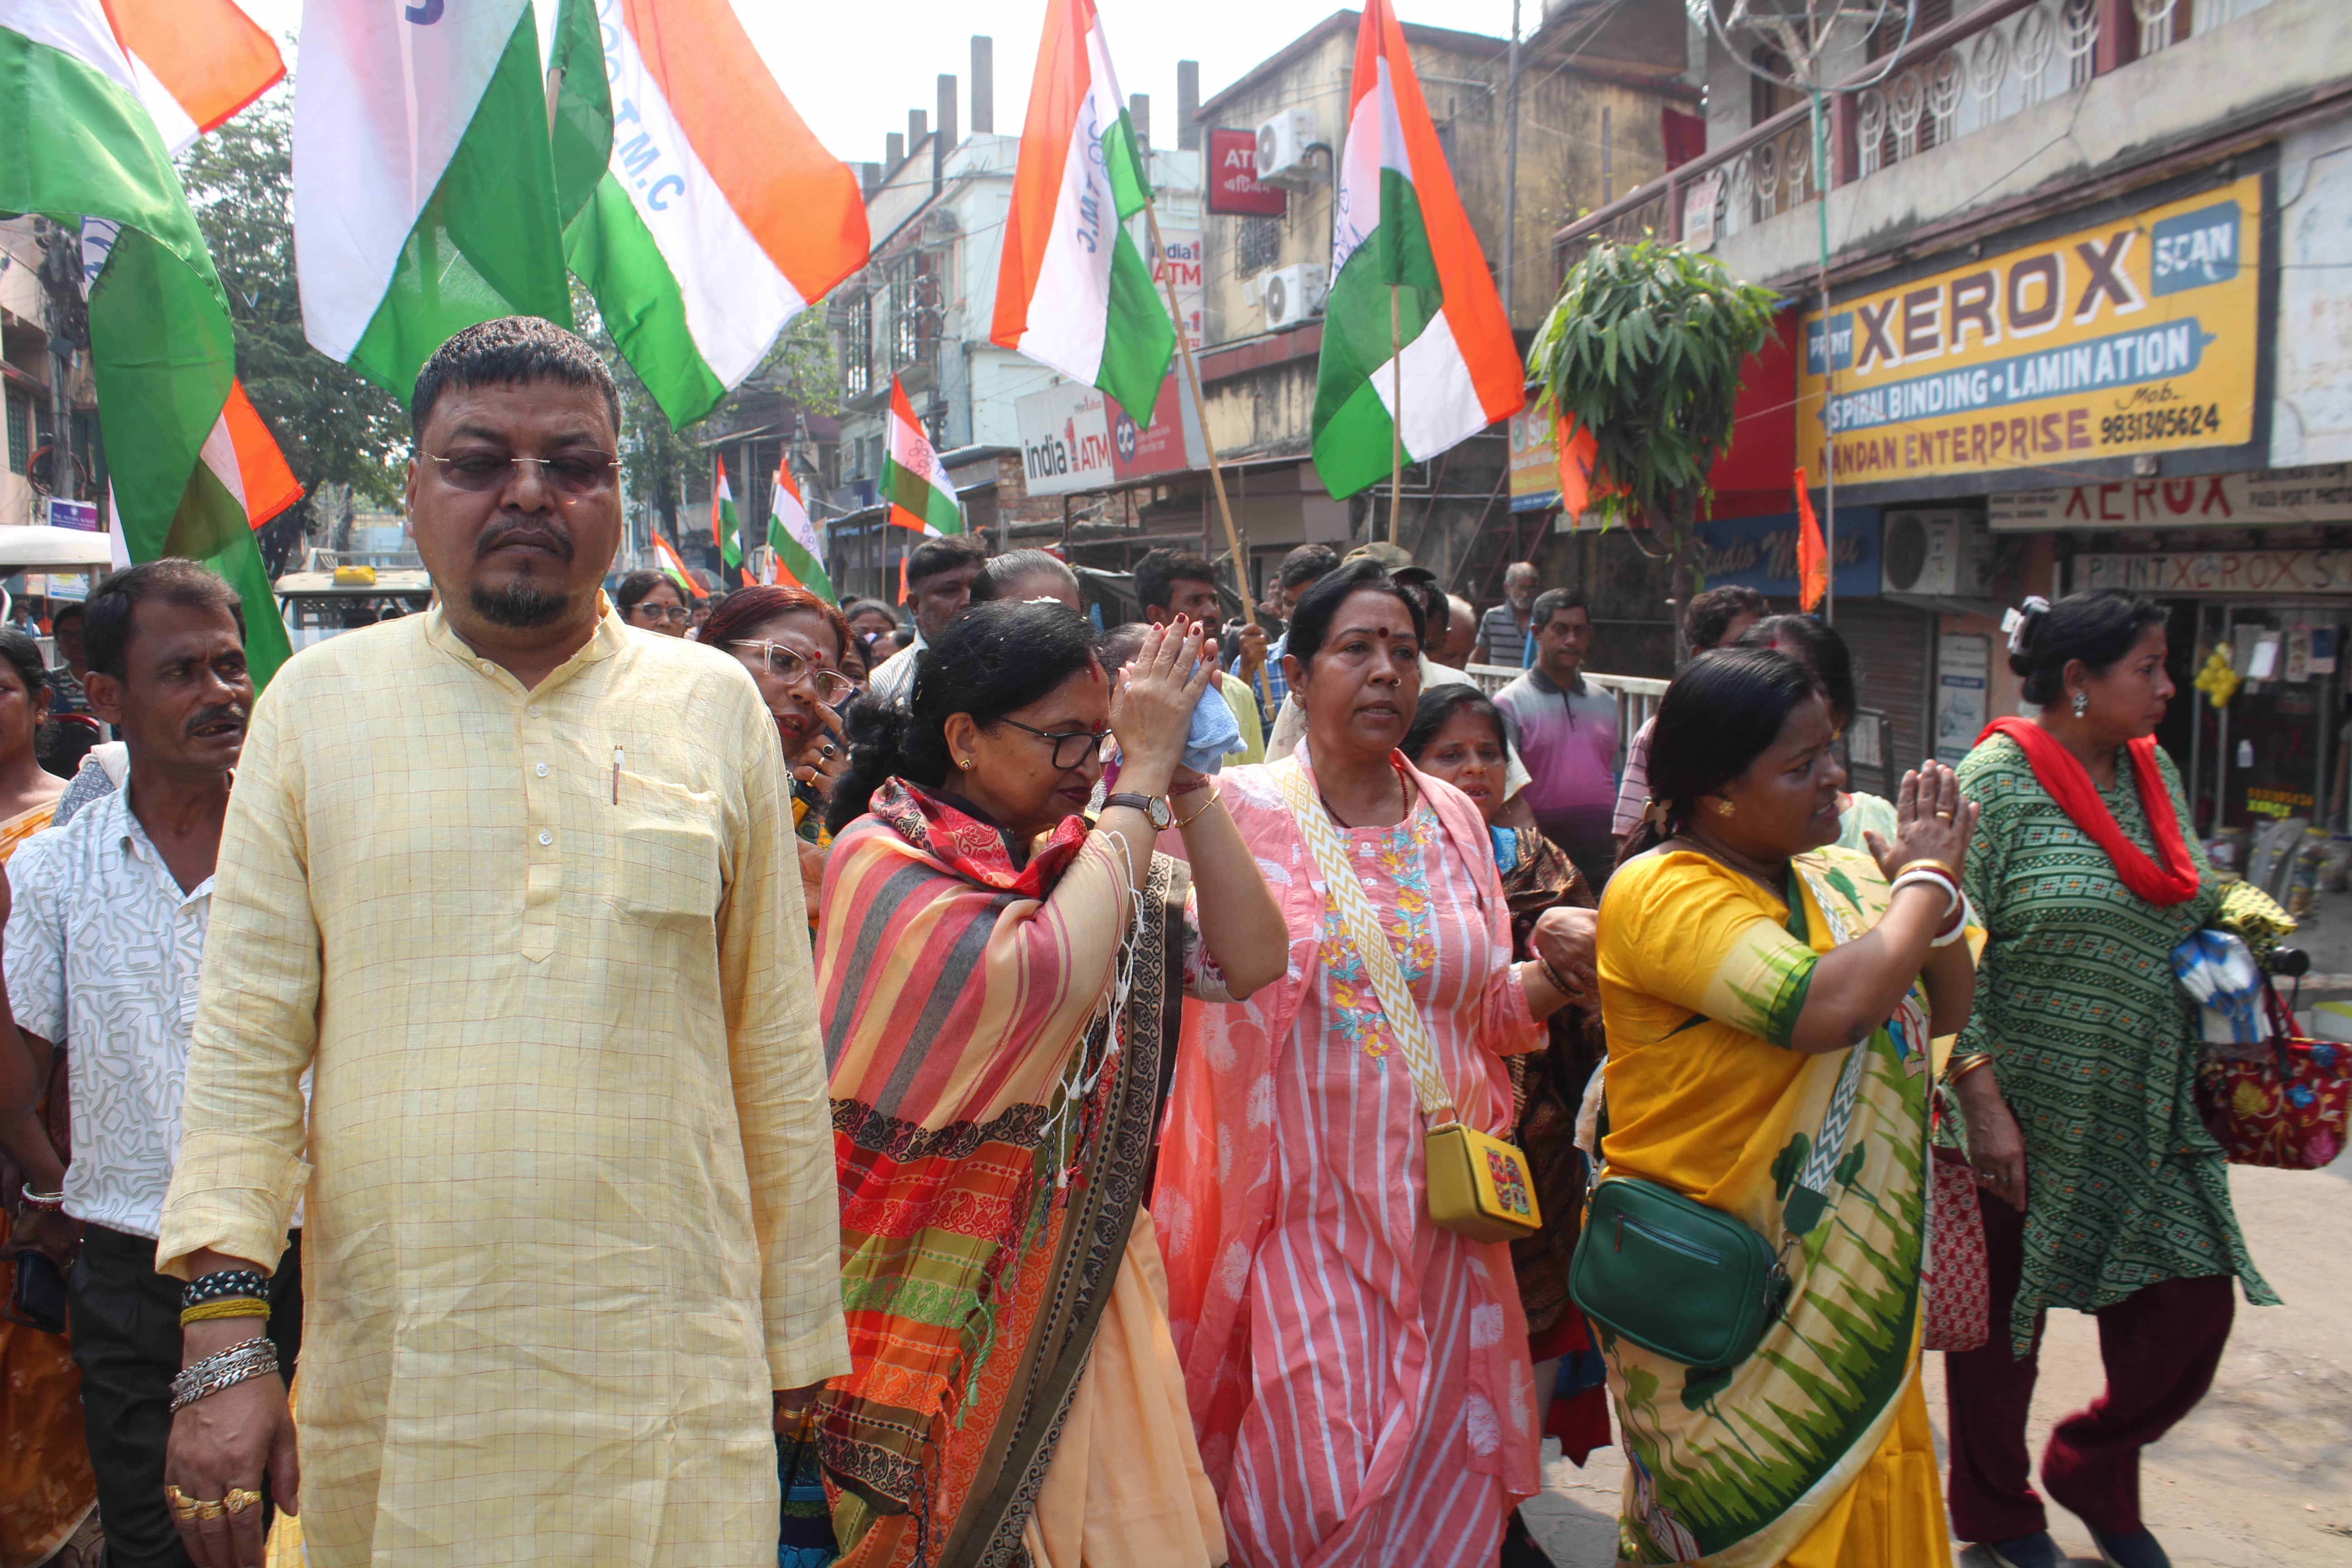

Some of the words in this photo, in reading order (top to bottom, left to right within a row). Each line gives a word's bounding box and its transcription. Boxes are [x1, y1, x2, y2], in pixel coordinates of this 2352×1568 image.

[2155, 222, 2233, 281] SCAN
[1153, 263, 1201, 285] ATM
[1855, 230, 2146, 376] XEROX
[1810, 328, 1852, 357] PRNT
[1831, 389, 1886, 428] SPIRAL
[1889, 370, 1988, 419] BINDING
[2007, 325, 2190, 399] LAMINATION
[1818, 436, 1897, 478] NANDAN
[1905, 407, 2093, 468] ENTERPRISE
[2101, 402, 2220, 445] 9831305624
[1082, 433, 1111, 470] ATM
[2170, 551, 2306, 589] XEROX
